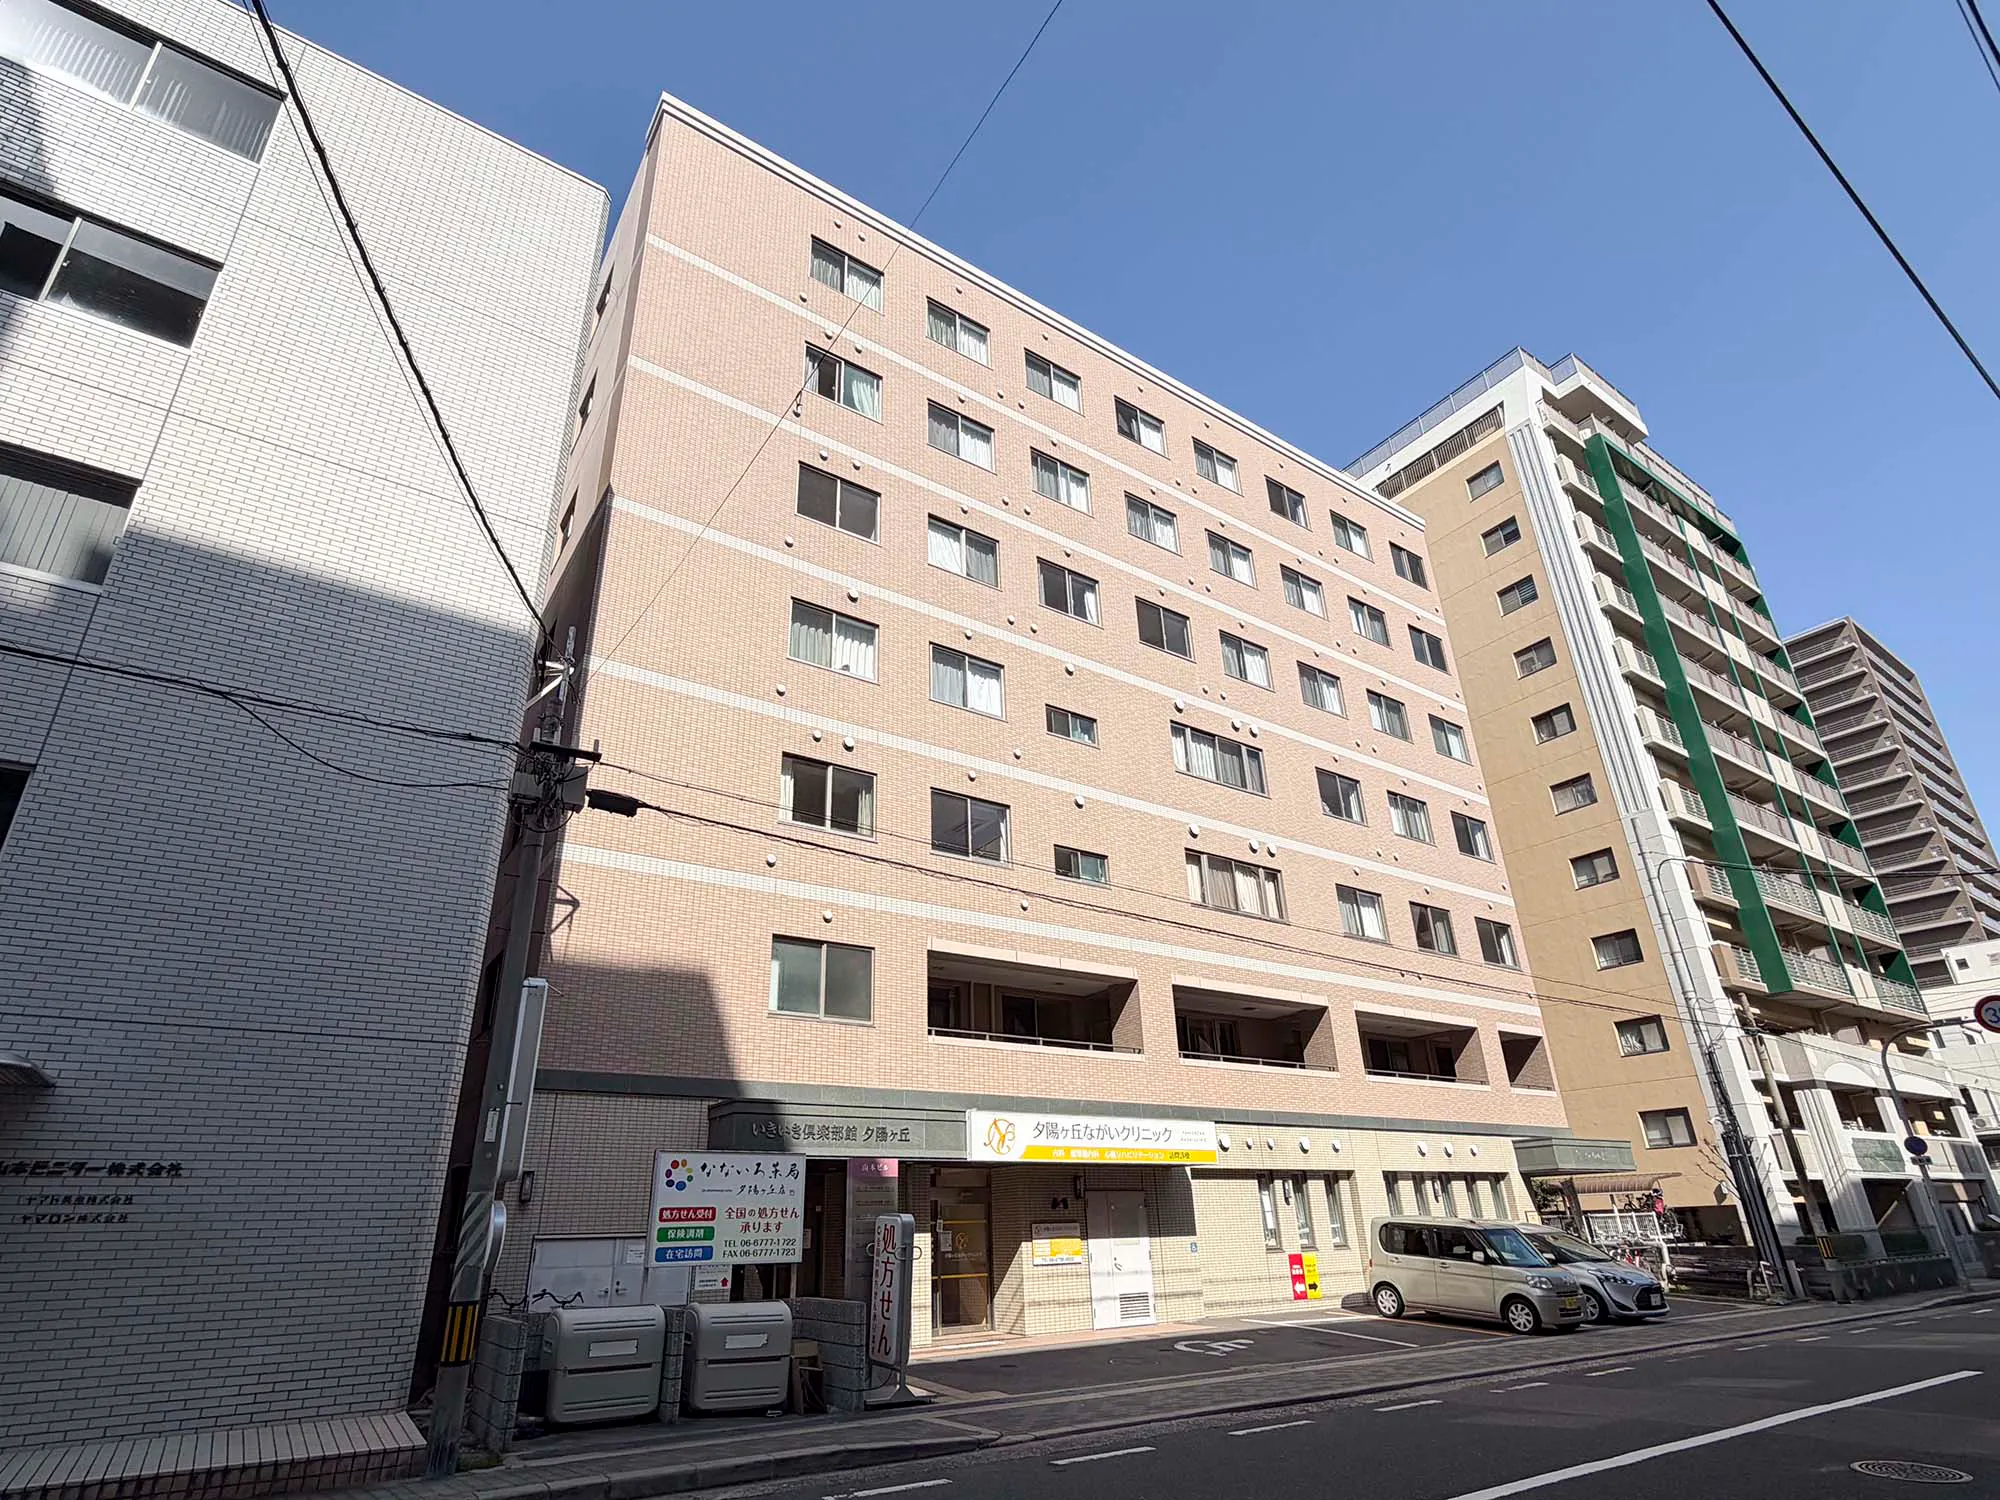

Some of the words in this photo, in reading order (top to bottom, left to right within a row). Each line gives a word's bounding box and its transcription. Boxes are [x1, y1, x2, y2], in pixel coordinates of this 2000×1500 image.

[752, 1121, 858, 1141] いきいき倶楽部館
[700, 1161, 800, 1180] なないろ薬局
[662, 1209, 713, 1219] 処方せん受付
[725, 1206, 800, 1219] 全国の処方せん
[740, 1221, 783, 1233] 承ります
[723, 1239, 738, 1247] TEL
[740, 1238, 797, 1247] 06-6777-1722
[665, 1248, 703, 1259] 在宅訪問
[722, 1250, 738, 1258] FAX
[740, 1248, 796, 1257] 06-6777-1723
[877, 1223, 897, 1356] 処方せん
